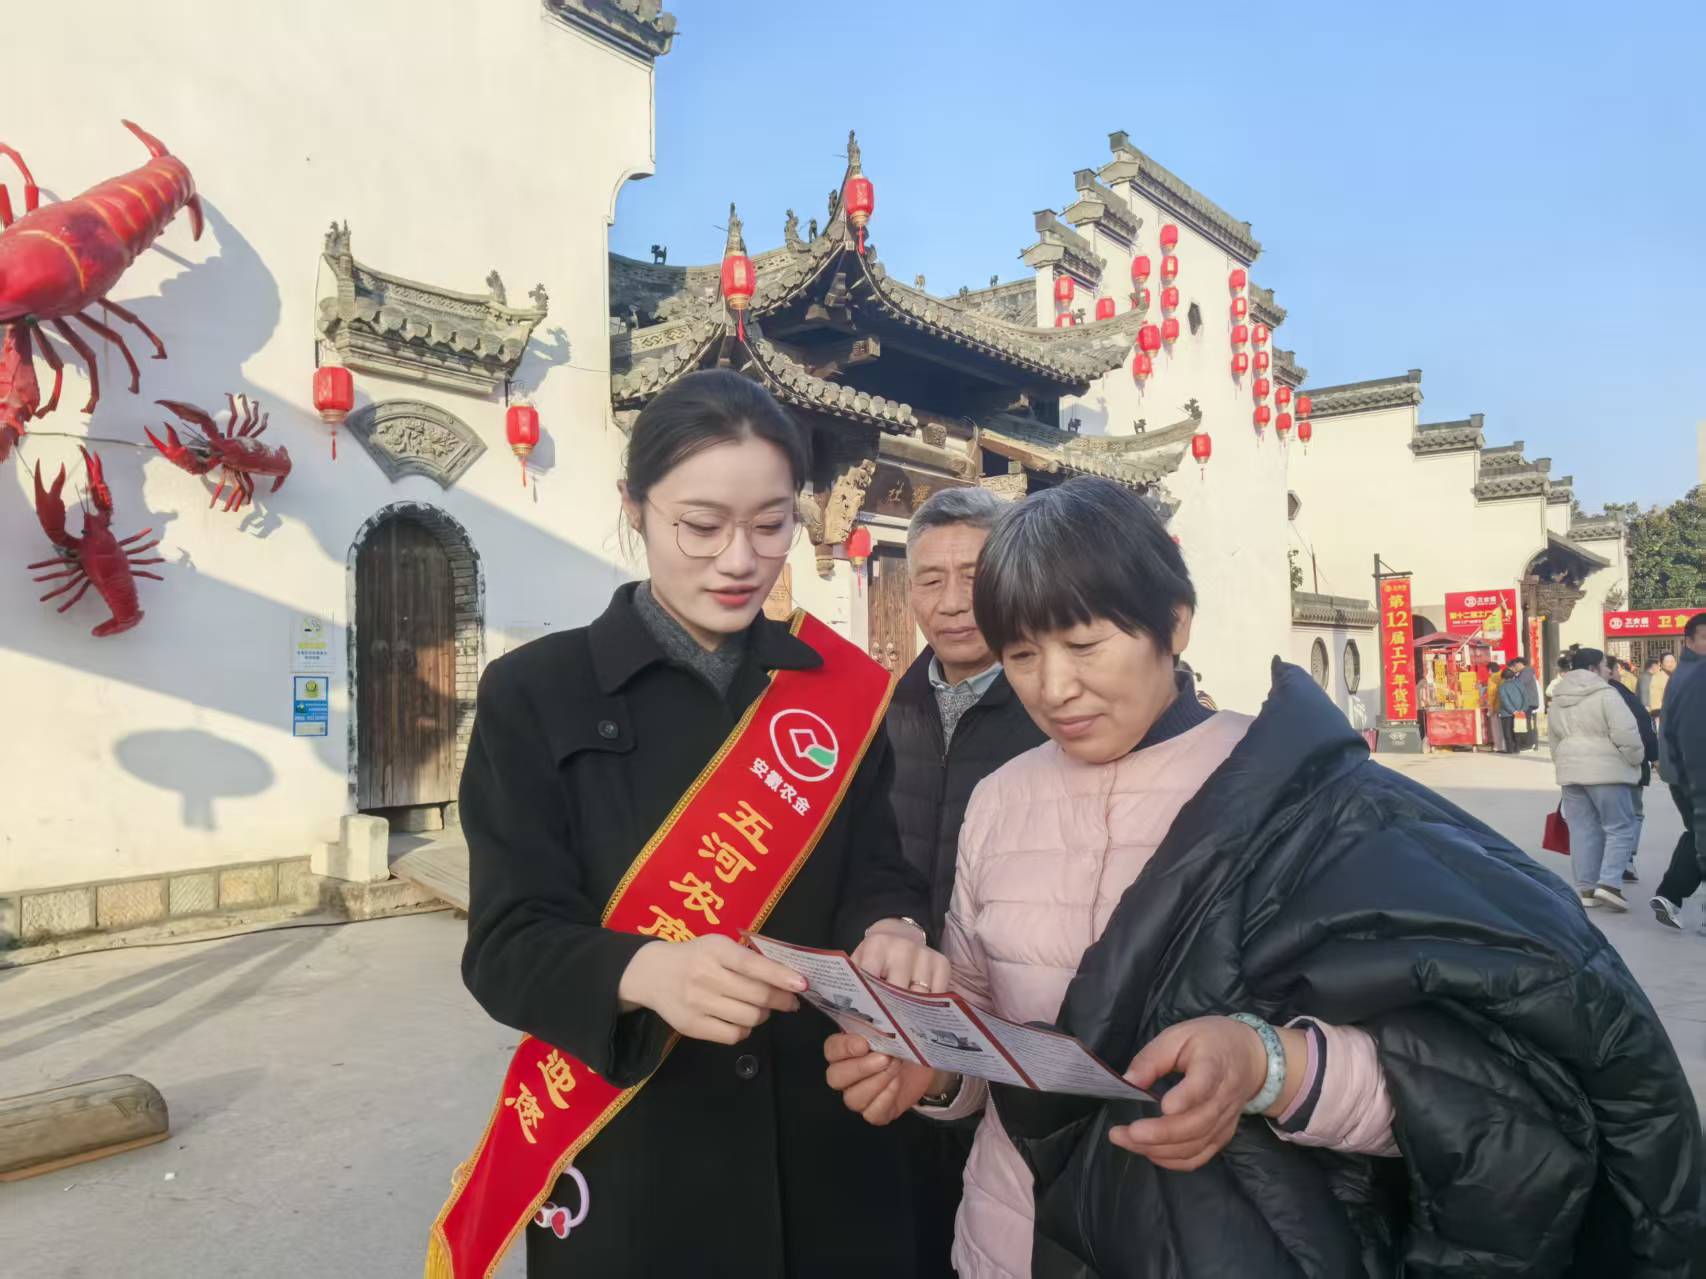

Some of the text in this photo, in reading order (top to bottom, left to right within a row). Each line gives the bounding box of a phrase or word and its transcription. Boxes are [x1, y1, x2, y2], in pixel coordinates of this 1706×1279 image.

[1386, 594, 1410, 718] 第12届工厂年货节
[749, 757, 811, 817] 安徽农金
[504, 1049, 597, 1144] 迎您
